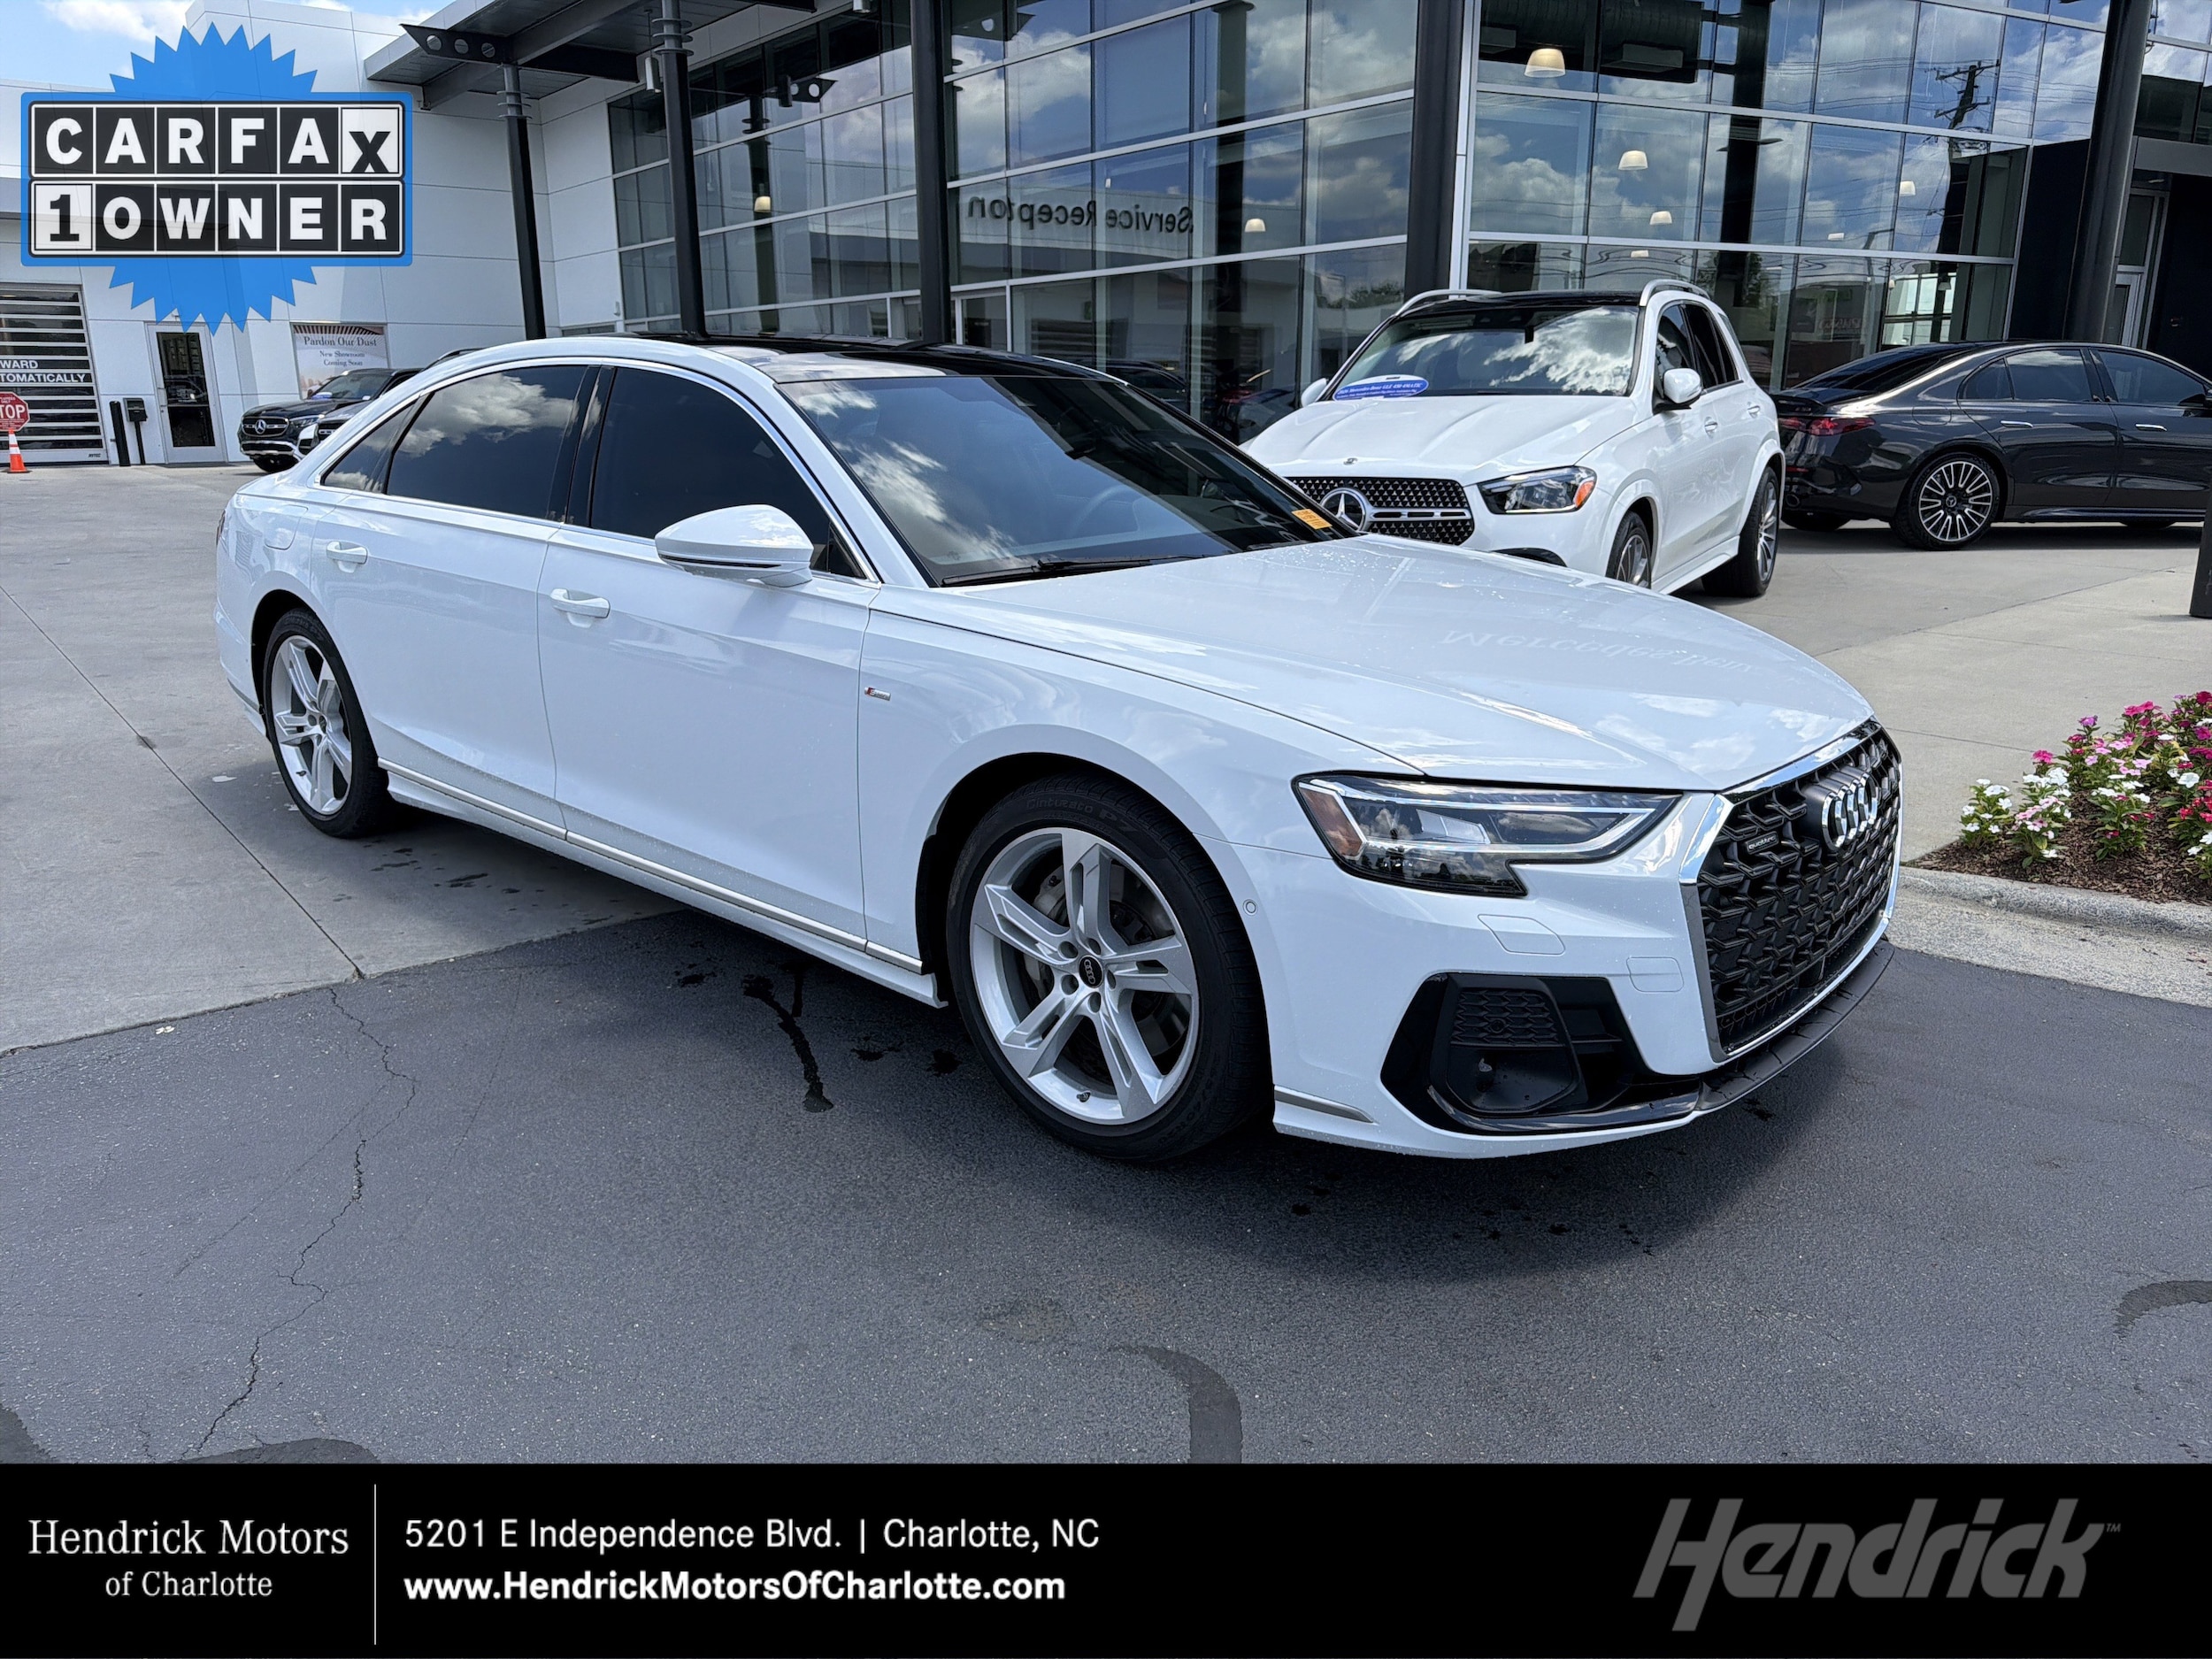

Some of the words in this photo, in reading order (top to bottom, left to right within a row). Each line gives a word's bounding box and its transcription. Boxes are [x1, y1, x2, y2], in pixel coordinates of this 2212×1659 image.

[303, 336, 335, 346] Pardon
[338, 336, 354, 346] Our
[357, 336, 377, 346] Dust
[0, 360, 38, 369] WARD
